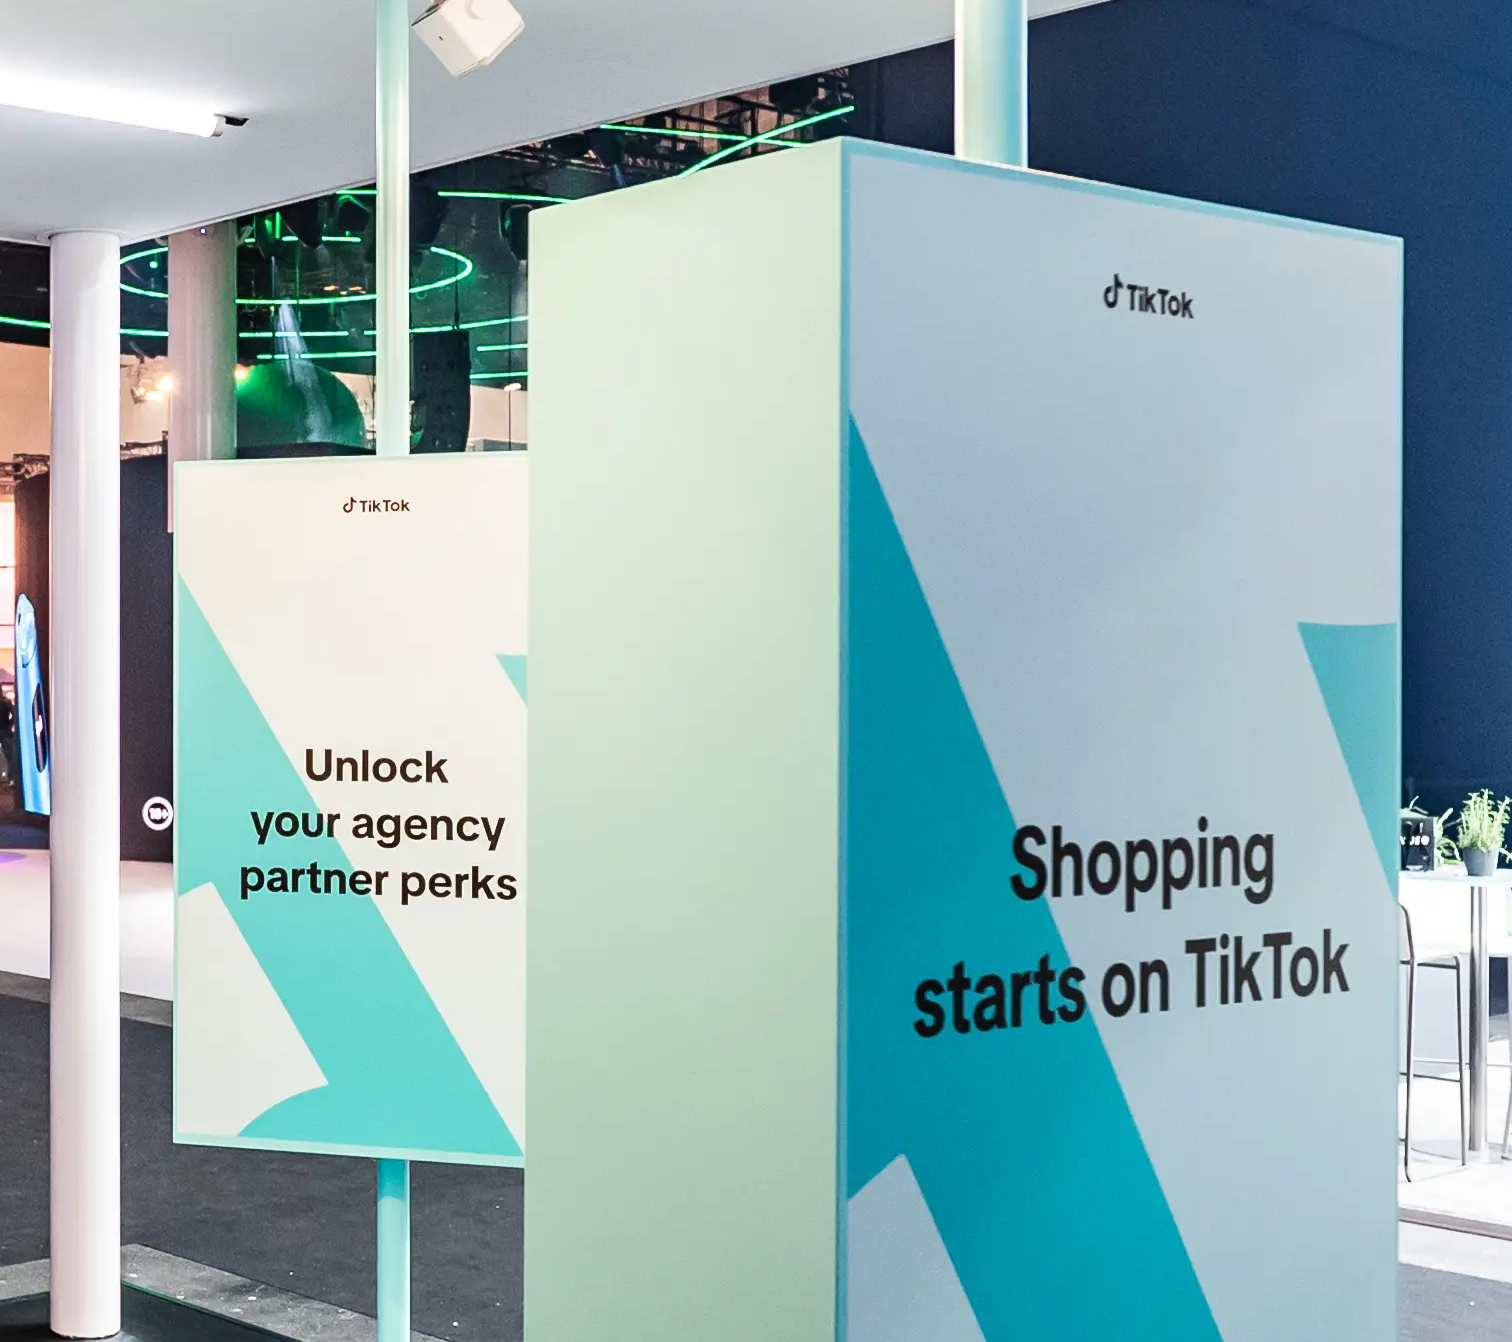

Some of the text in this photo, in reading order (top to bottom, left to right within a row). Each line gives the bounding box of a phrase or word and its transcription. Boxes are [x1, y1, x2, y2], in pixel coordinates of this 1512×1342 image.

[1127, 284, 1193, 318] TikTok
[360, 500, 409, 512] TikTok
[306, 749, 448, 783] Unlock
[251, 812, 505, 850] your agency
[241, 862, 516, 905] partner perks
[1010, 817, 1272, 912] Shopping
[913, 929, 1348, 1038] starts on TikTok
